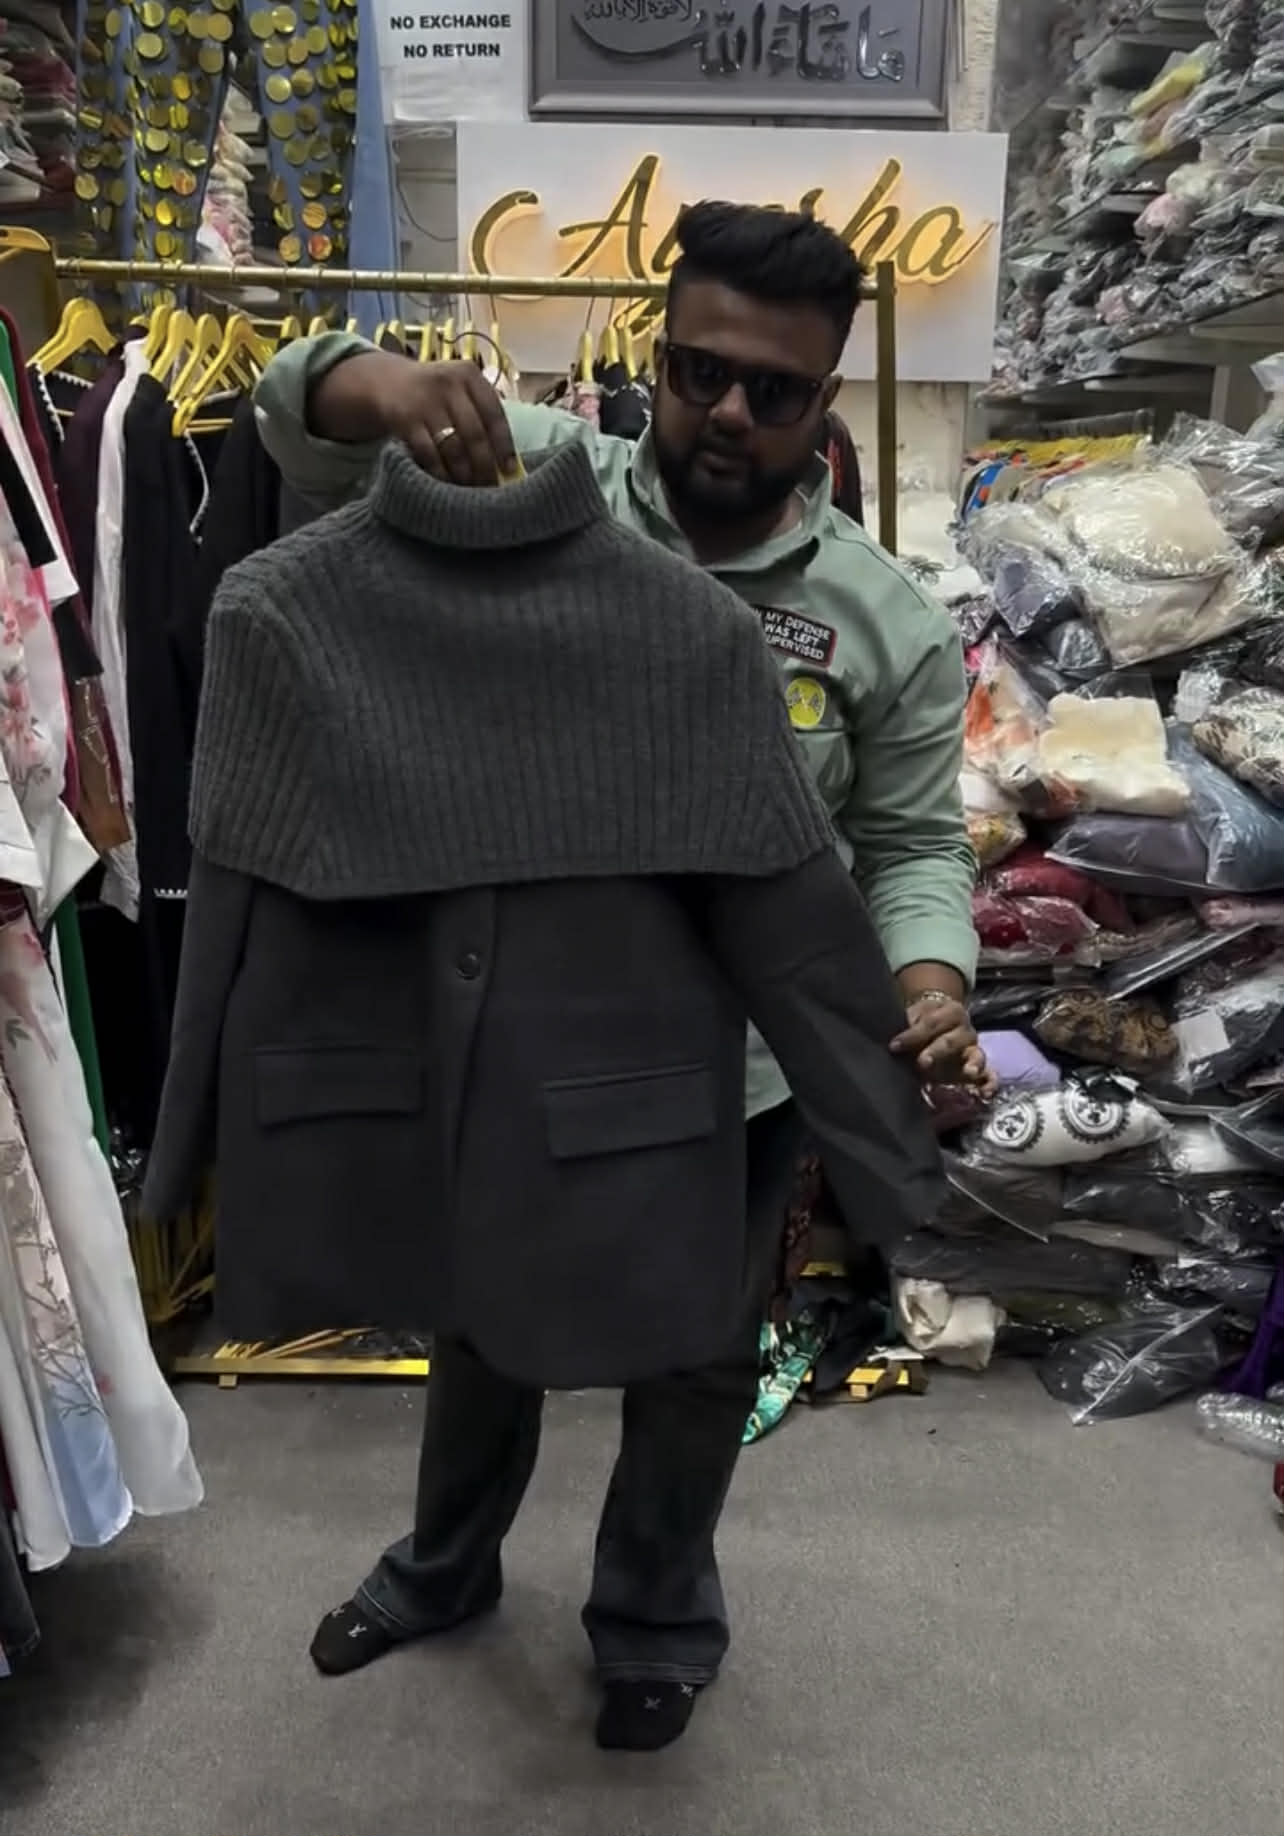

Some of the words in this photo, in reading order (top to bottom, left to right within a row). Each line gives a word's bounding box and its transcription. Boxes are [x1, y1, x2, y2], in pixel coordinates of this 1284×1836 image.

[390, 16, 414, 29] NO
[419, 14, 511, 29] EXCHANGE
[403, 44, 428, 58] NO
[432, 43, 501, 57] RETURN
[764, 623, 790, 637] WAS
[793, 630, 820, 646] LEFT
[785, 615, 830, 641] DEFENSE
